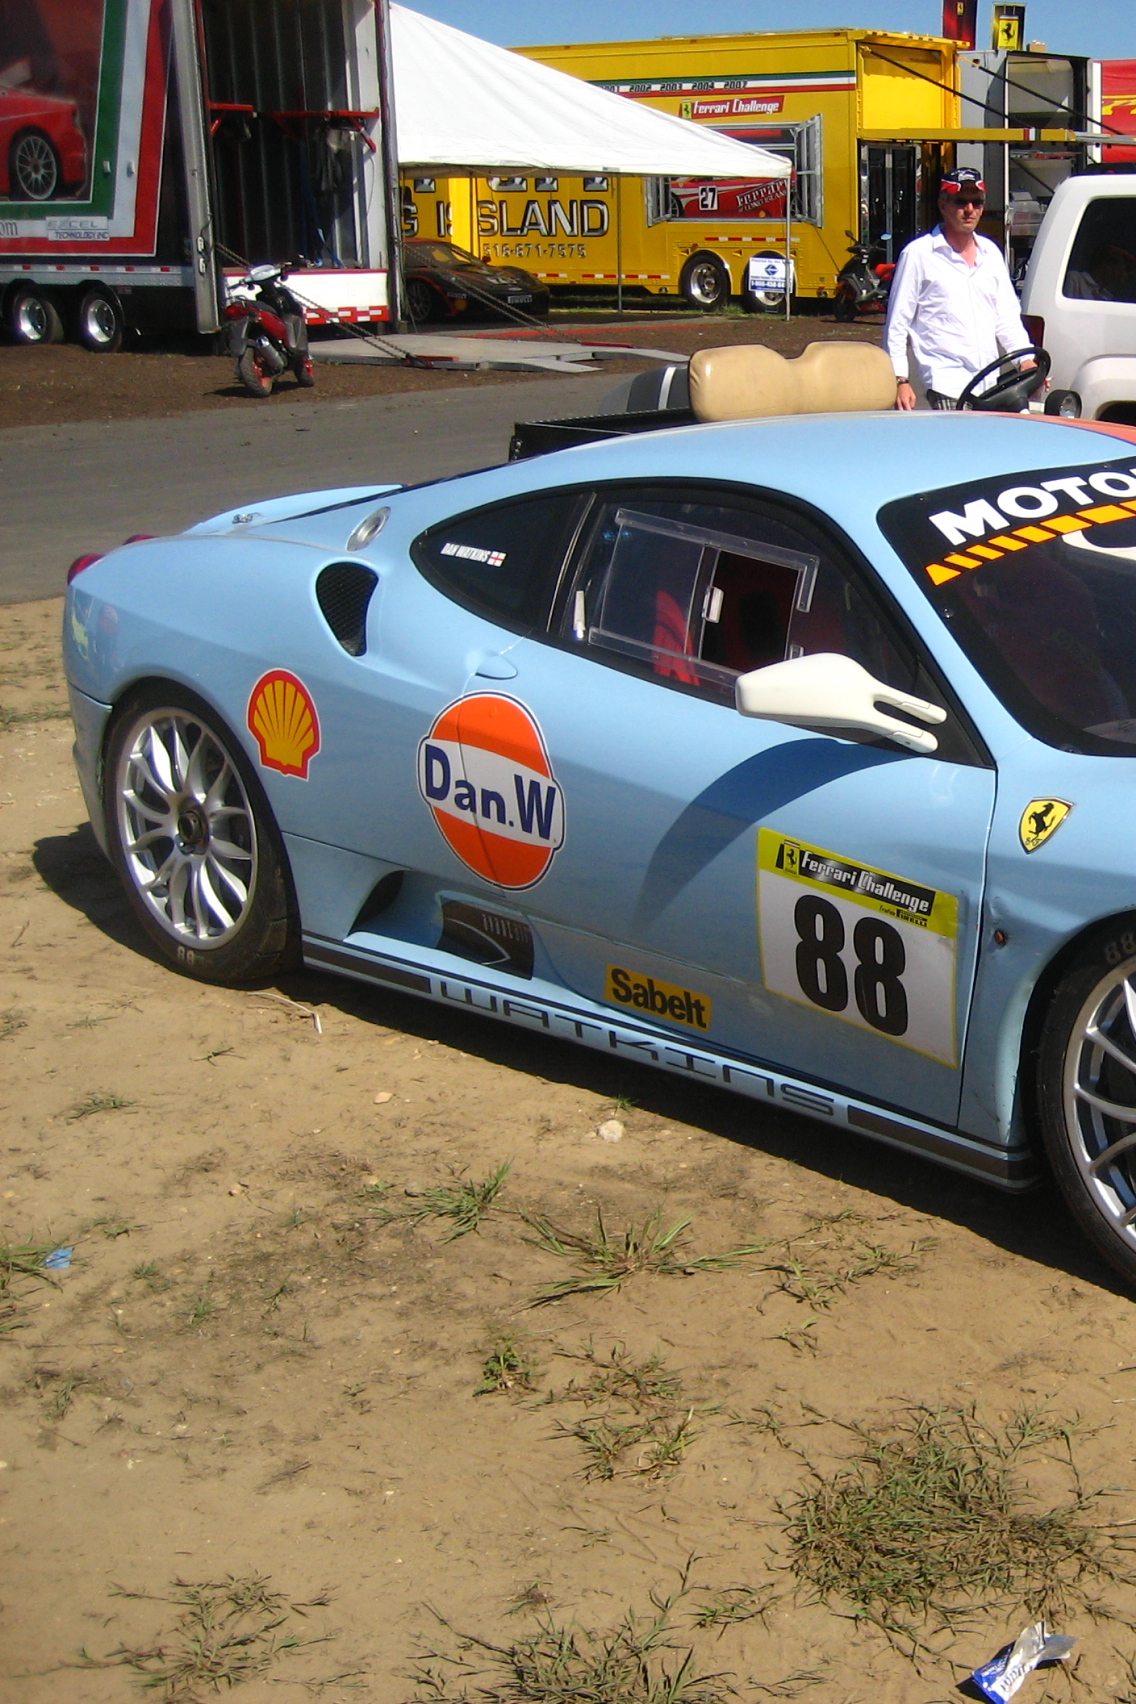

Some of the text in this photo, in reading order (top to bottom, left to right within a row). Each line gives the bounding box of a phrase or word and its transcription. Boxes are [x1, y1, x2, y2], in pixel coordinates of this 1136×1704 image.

[629, 85, 651, 93] 2002
[660, 83, 682, 92] 2003
[692, 82, 715, 90] 2004
[723, 80, 748, 89] 2007
[693, 99, 780, 114] Ferrari Challenge
[701, 186, 716, 209] 27
[424, 742, 557, 841] Dan.W
[801, 851, 930, 913] Ferrari Challenge
[895, 908, 928, 928] PIRELLI
[794, 894, 909, 1037] 88
[611, 968, 707, 1029] Sabelt
